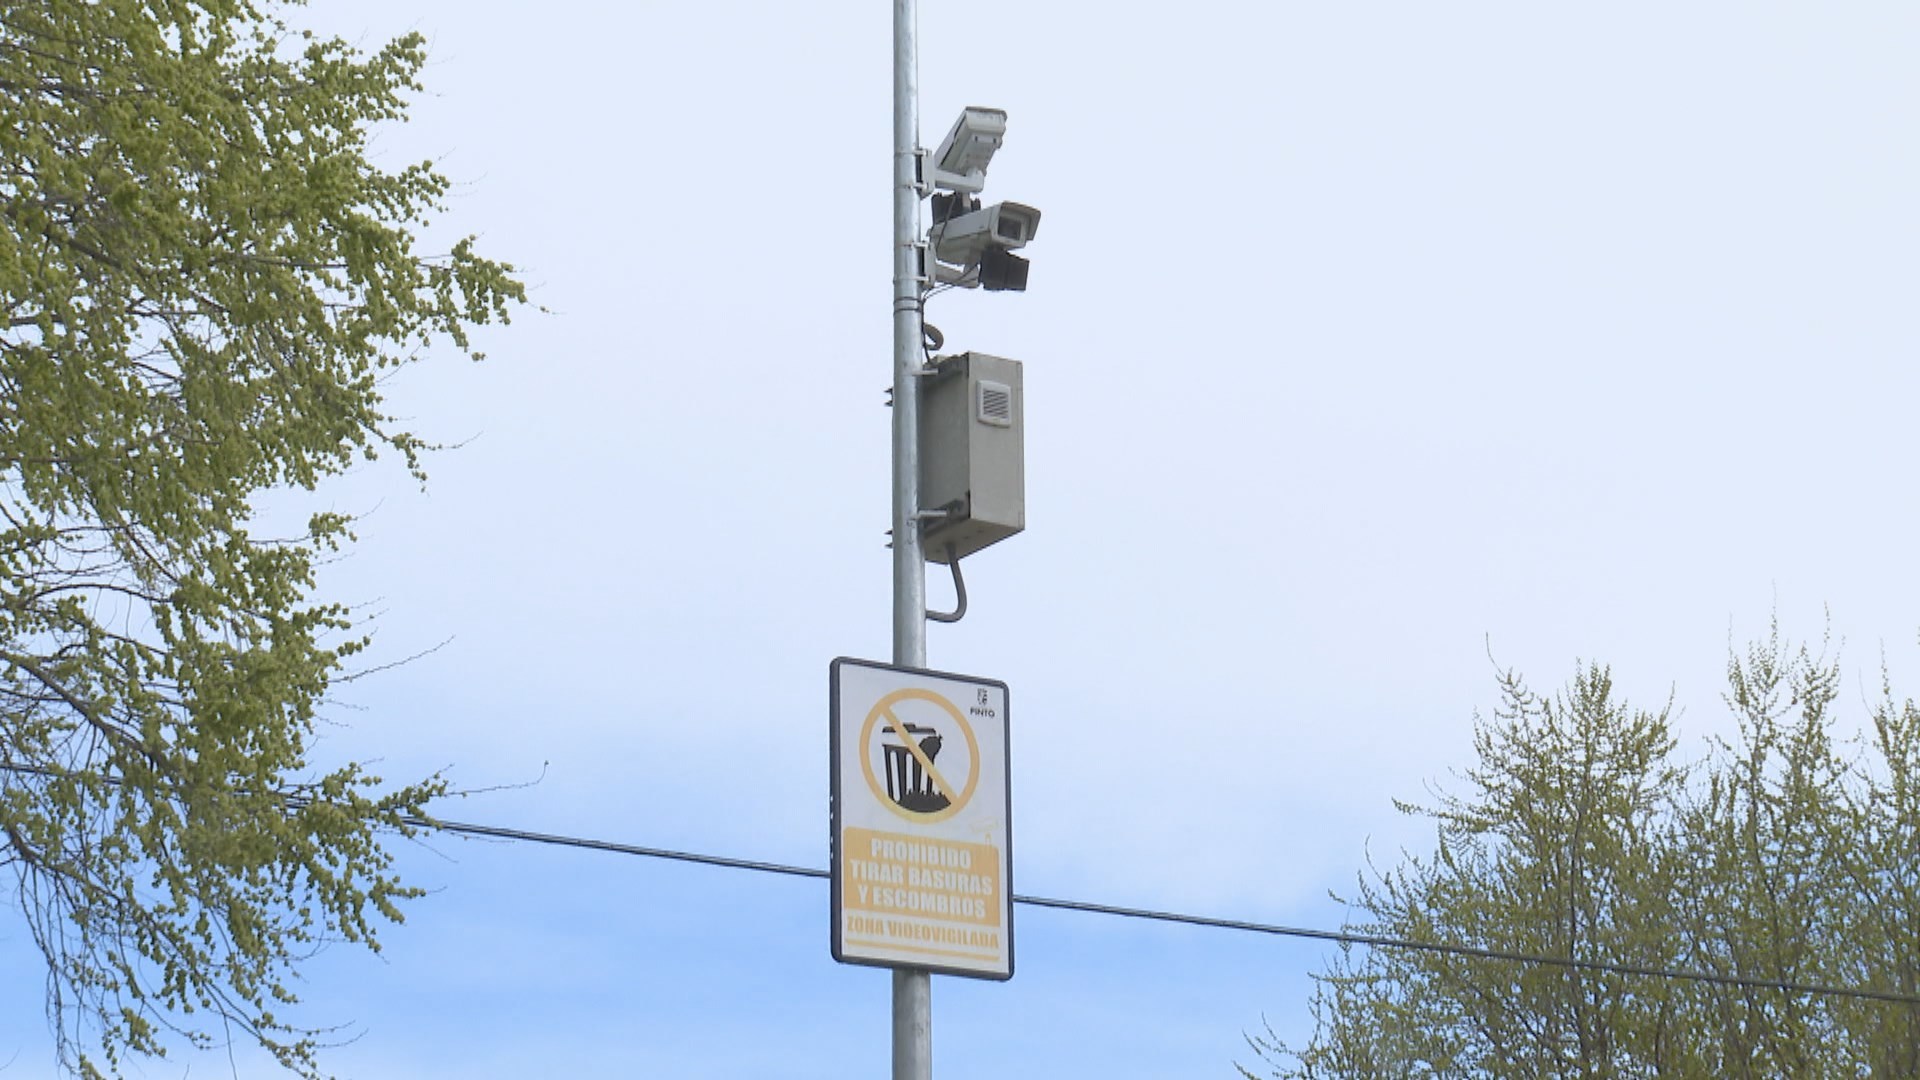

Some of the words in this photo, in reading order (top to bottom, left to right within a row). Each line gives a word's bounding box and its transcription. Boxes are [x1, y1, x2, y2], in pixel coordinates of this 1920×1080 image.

[970, 706, 995, 717] PINTO
[871, 837, 971, 869] PROHIBIDO
[849, 858, 904, 884] TIRAR
[908, 867, 992, 895] BASURAS
[857, 884, 868, 904] Y
[873, 887, 985, 919] ESCOMBROS
[847, 915, 884, 936] ZONA
[887, 920, 999, 949] VIDEOVIGILADA
